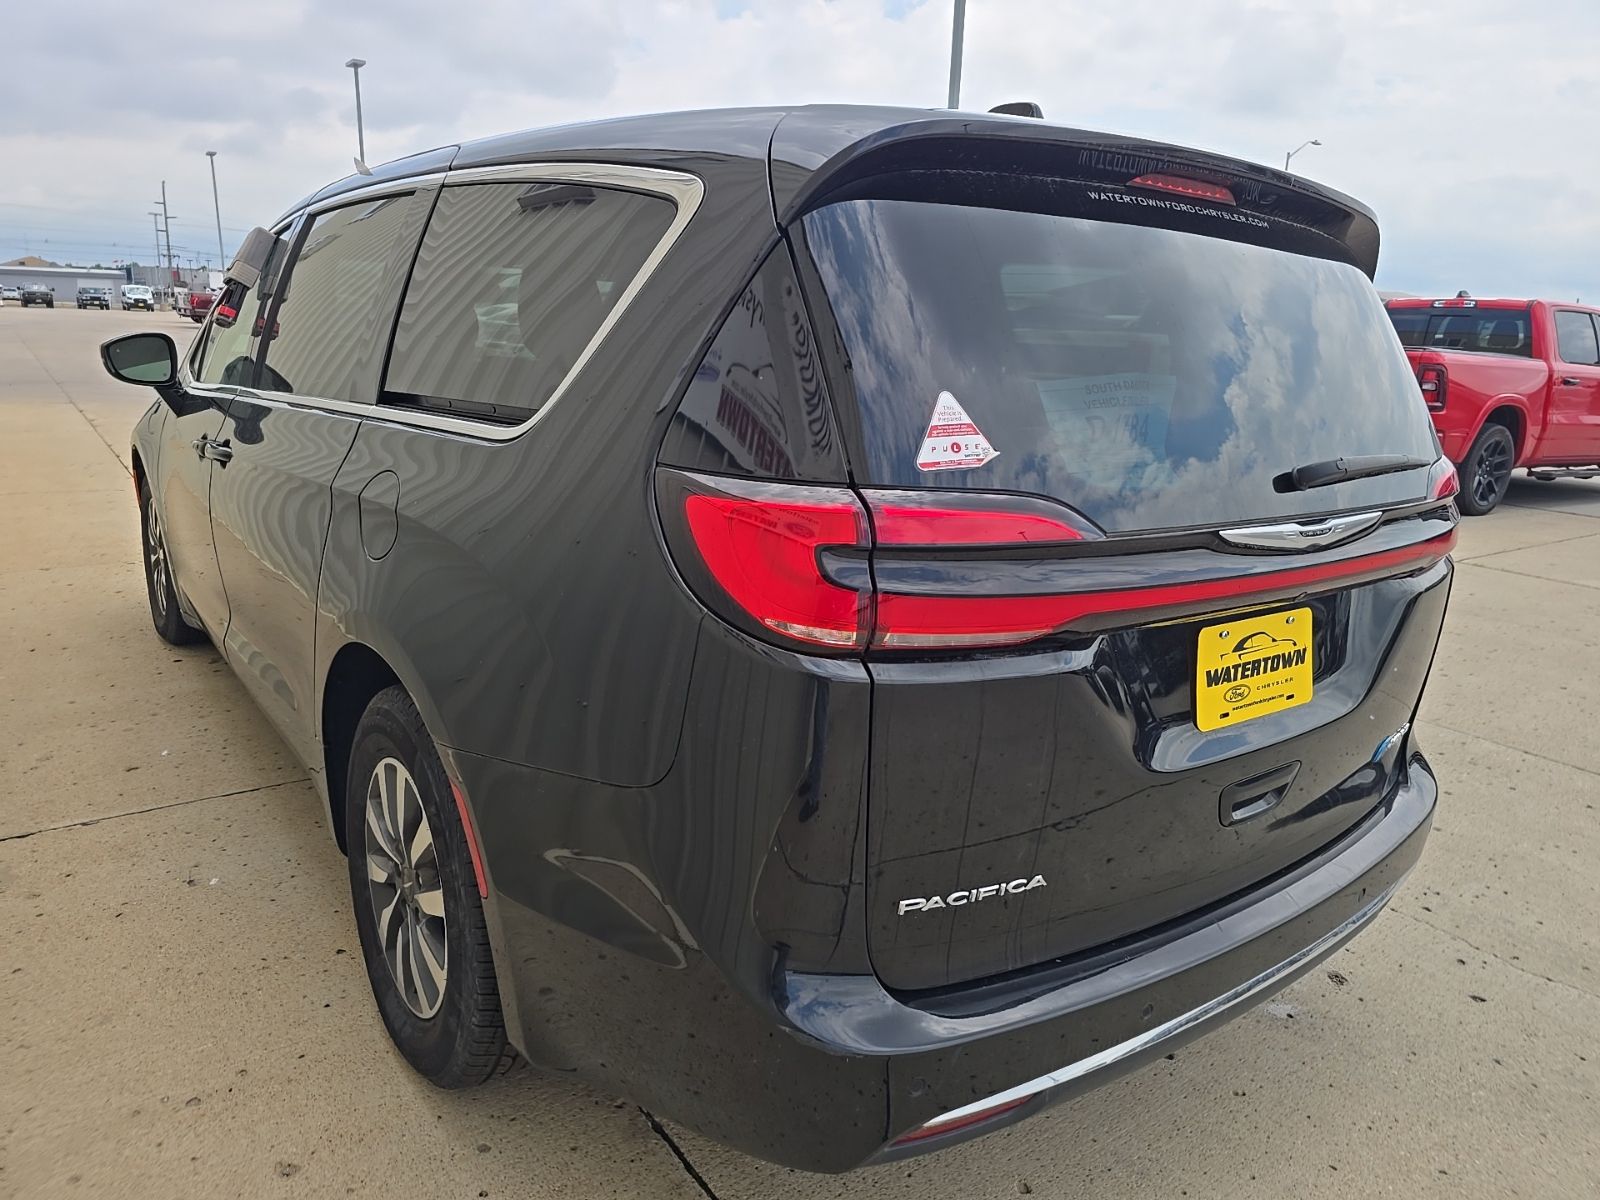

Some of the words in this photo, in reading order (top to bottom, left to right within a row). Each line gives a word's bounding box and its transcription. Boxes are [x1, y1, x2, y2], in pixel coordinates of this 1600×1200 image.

[1088, 191, 1269, 229] WATERTOWNFORDCHRYSLER.COM
[1205, 645, 1308, 688] WATERTOWN
[1256, 677, 1294, 691] CHRYSLER
[1228, 686, 1247, 701] Ford
[897, 874, 1048, 916] PACIFICA
